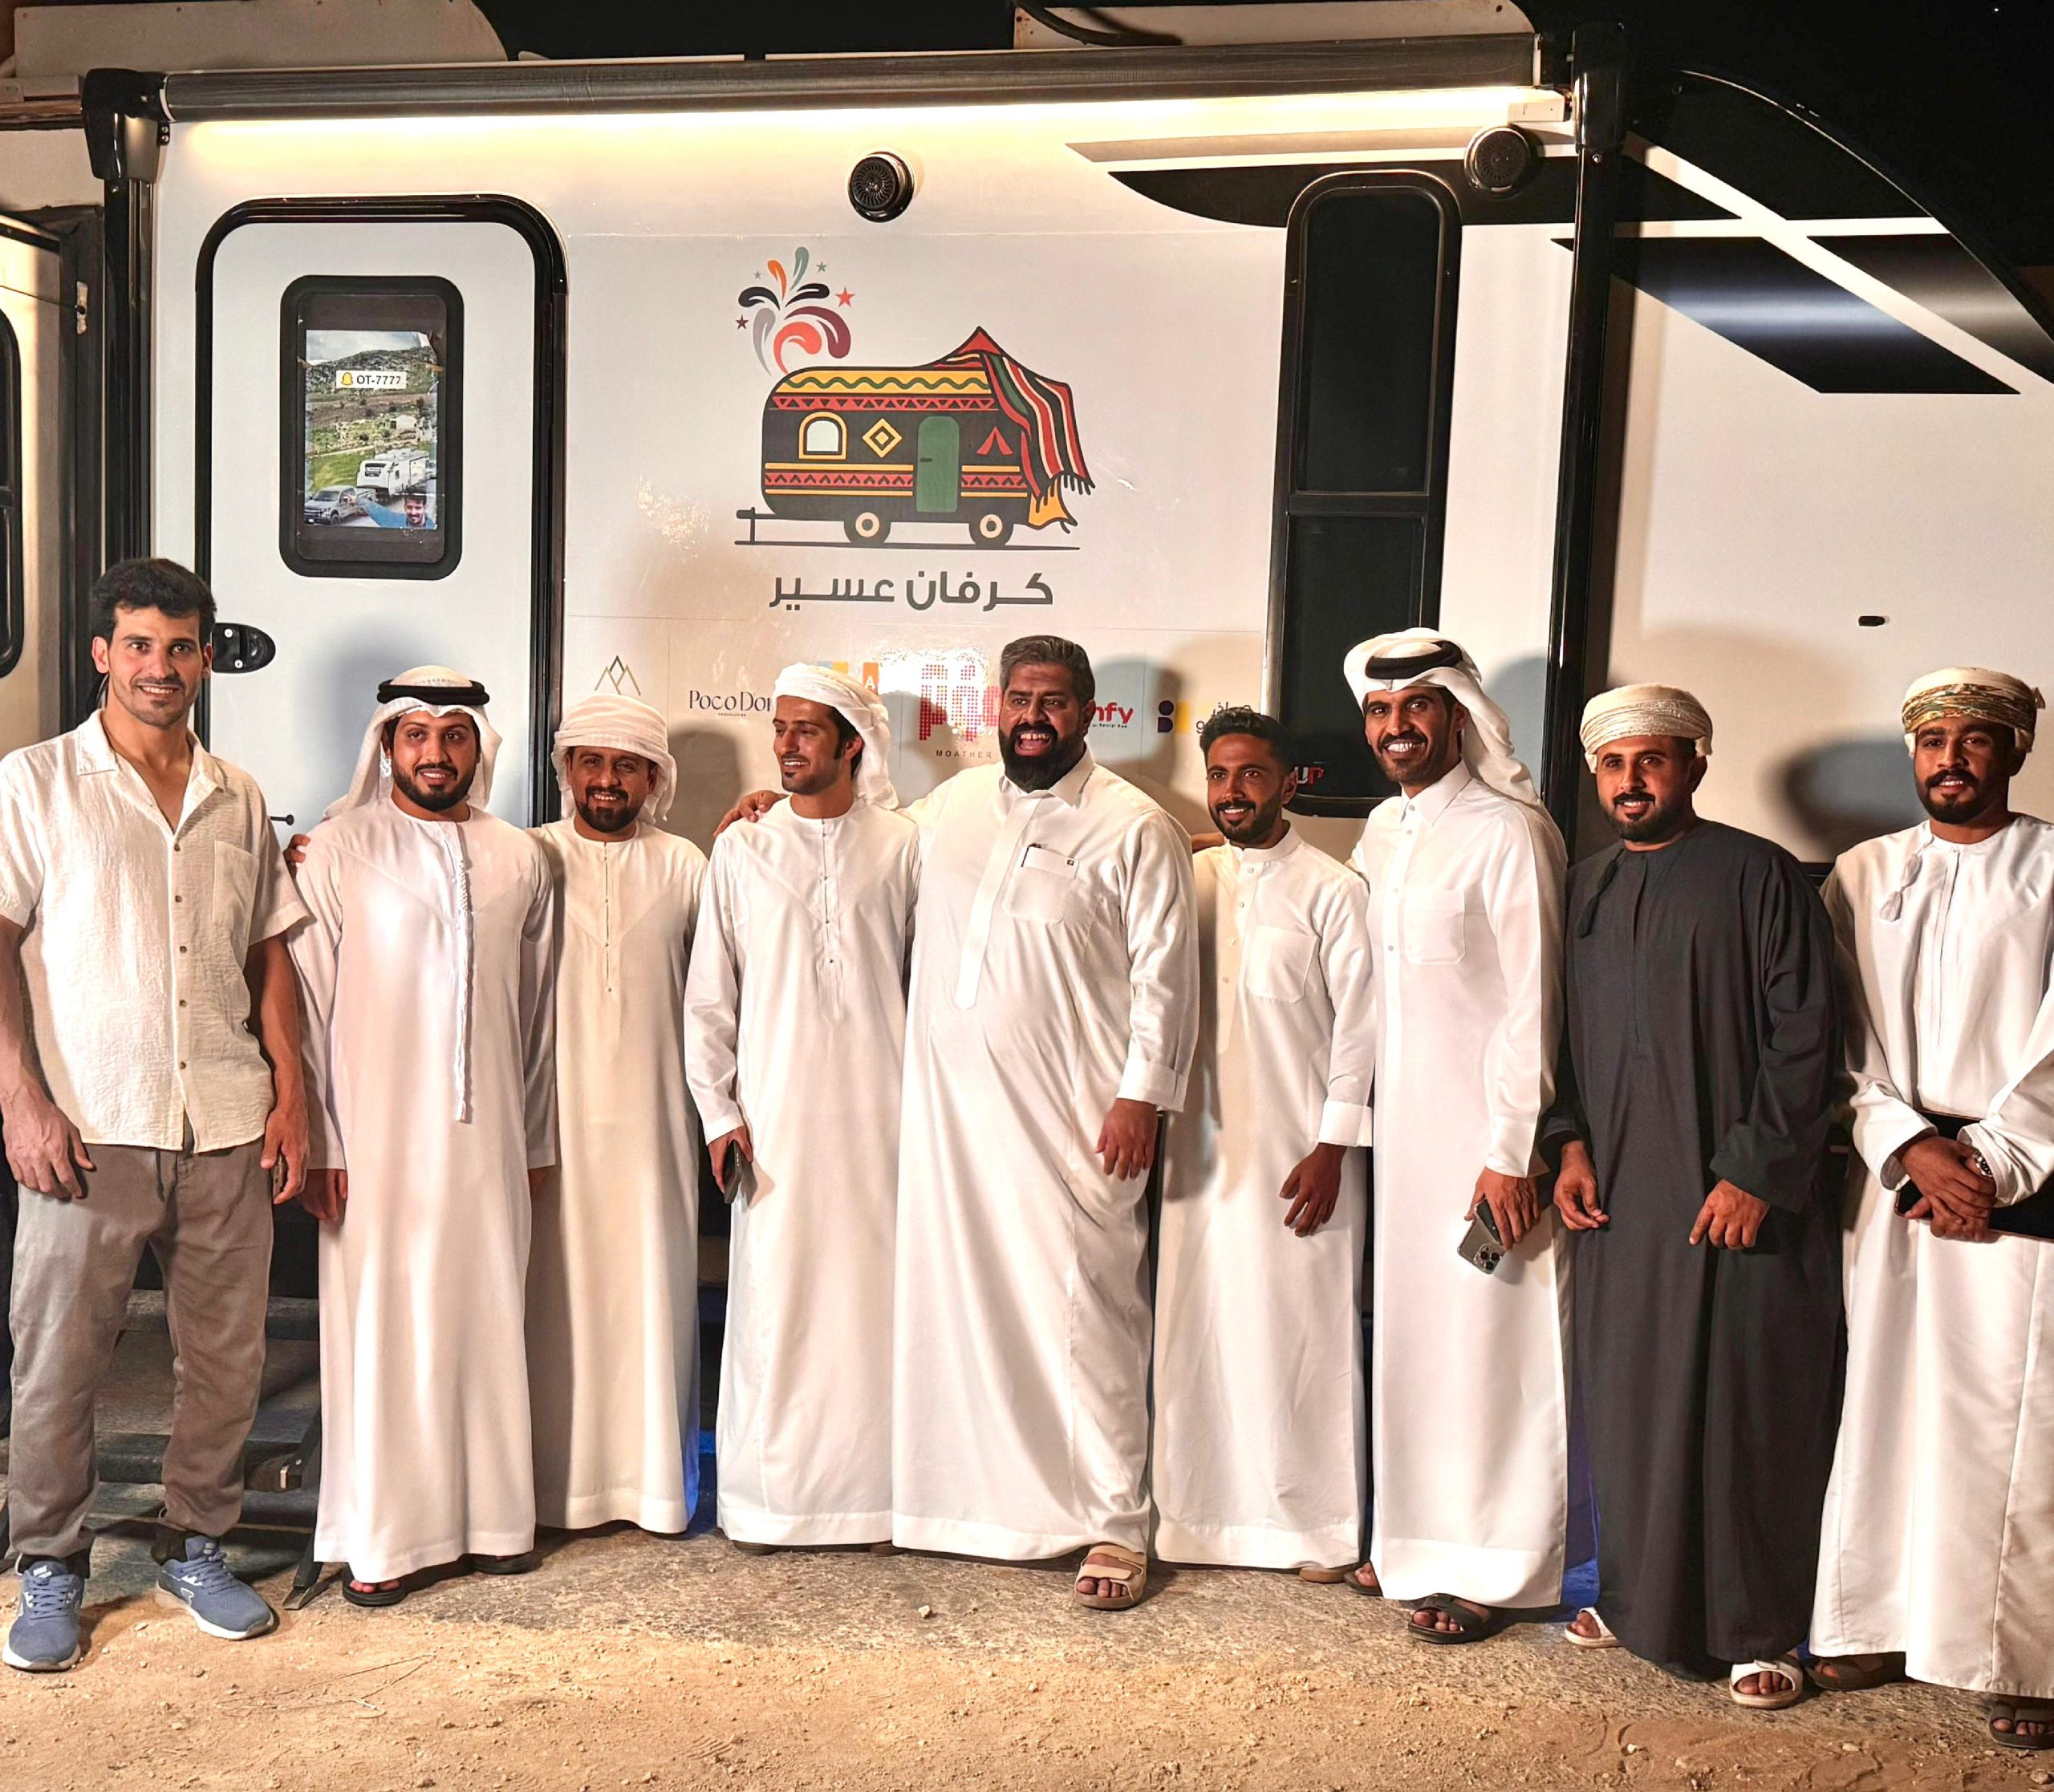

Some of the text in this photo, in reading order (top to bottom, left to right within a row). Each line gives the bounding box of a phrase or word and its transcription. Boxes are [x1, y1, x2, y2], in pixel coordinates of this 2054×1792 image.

[356, 375, 401, 385] OT-7777
[769, 570, 1053, 611] كرفان عسير
[936, 749, 992, 759] MOATHER
